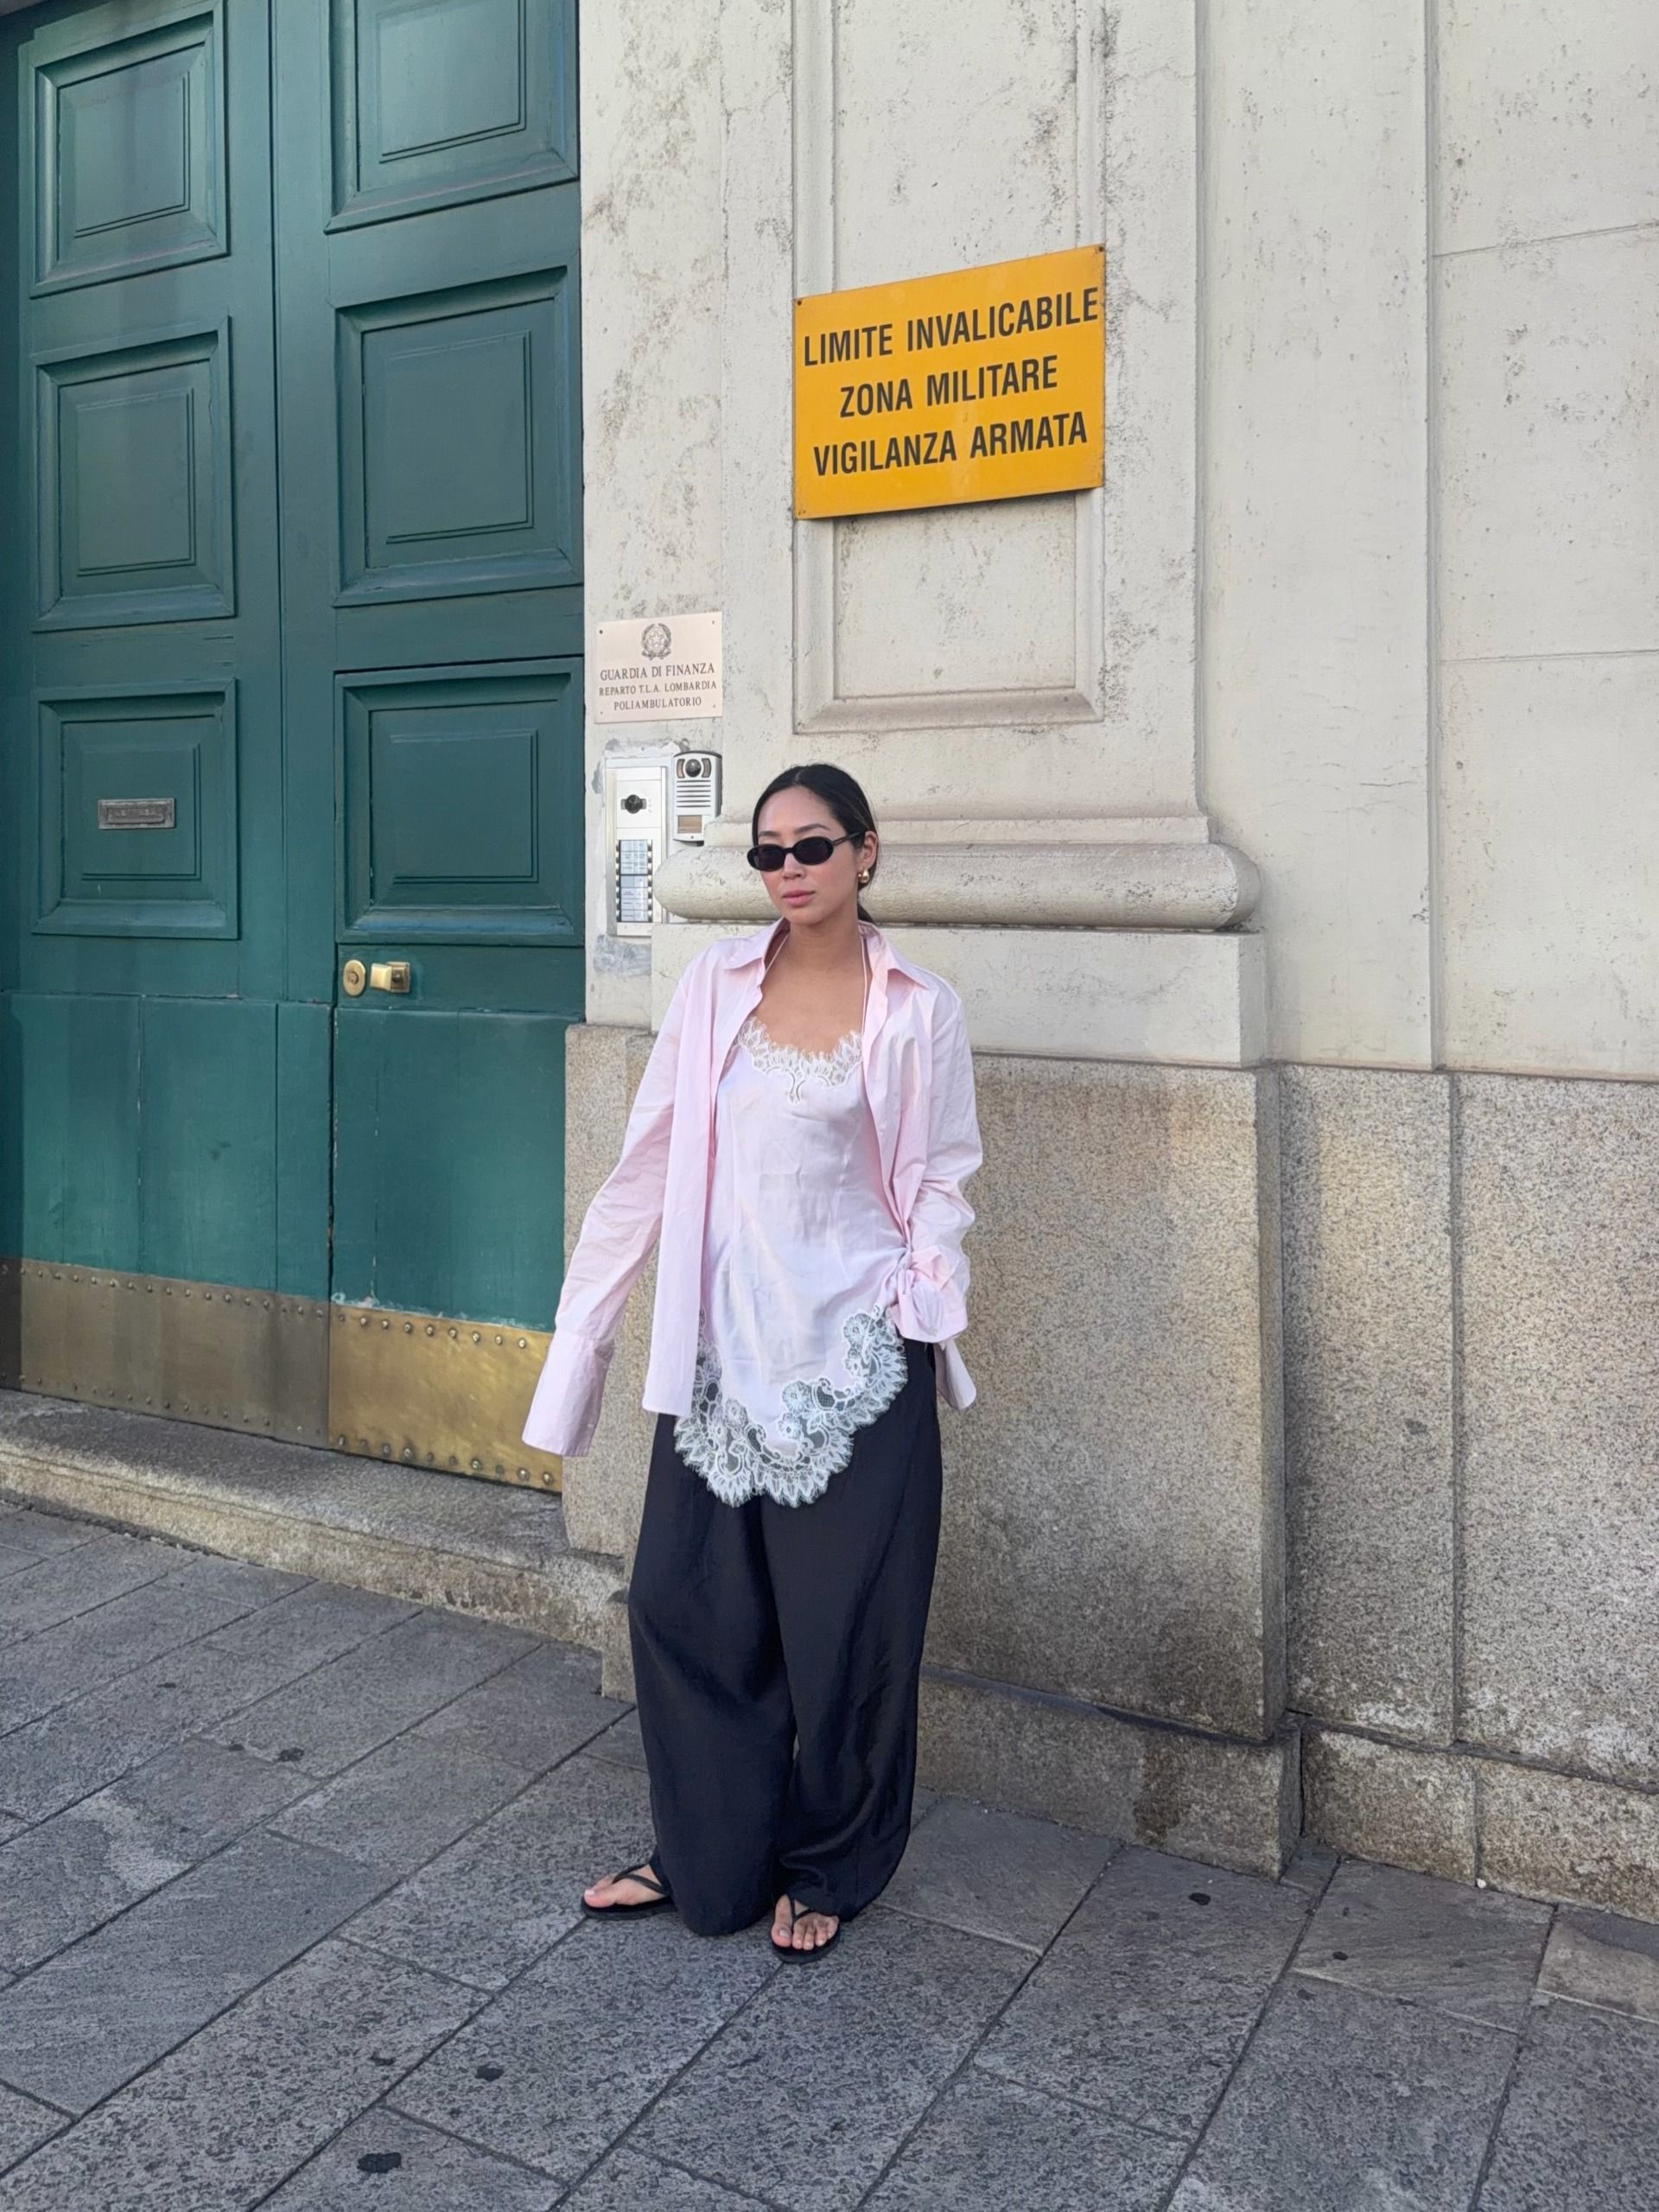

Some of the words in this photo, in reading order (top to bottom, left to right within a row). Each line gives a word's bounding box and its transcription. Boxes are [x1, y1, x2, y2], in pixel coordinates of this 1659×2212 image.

[804, 323, 893, 366] LIMITE
[906, 287, 1098, 353] INVALICABILE
[840, 378, 913, 418] ZONA
[926, 354, 1058, 407] MILITARE
[813, 429, 957, 477] VIGILANZA
[969, 410, 1087, 459] ARMATA
[599, 686, 637, 696] REPARTO
[664, 680, 717, 692] LOMBARDIA
[600, 667, 648, 681] GUARDIA
[652, 666, 662, 677] DI
[665, 662, 715, 677] FINANZA
[613, 696, 702, 711] POLIAMBULATORIO
